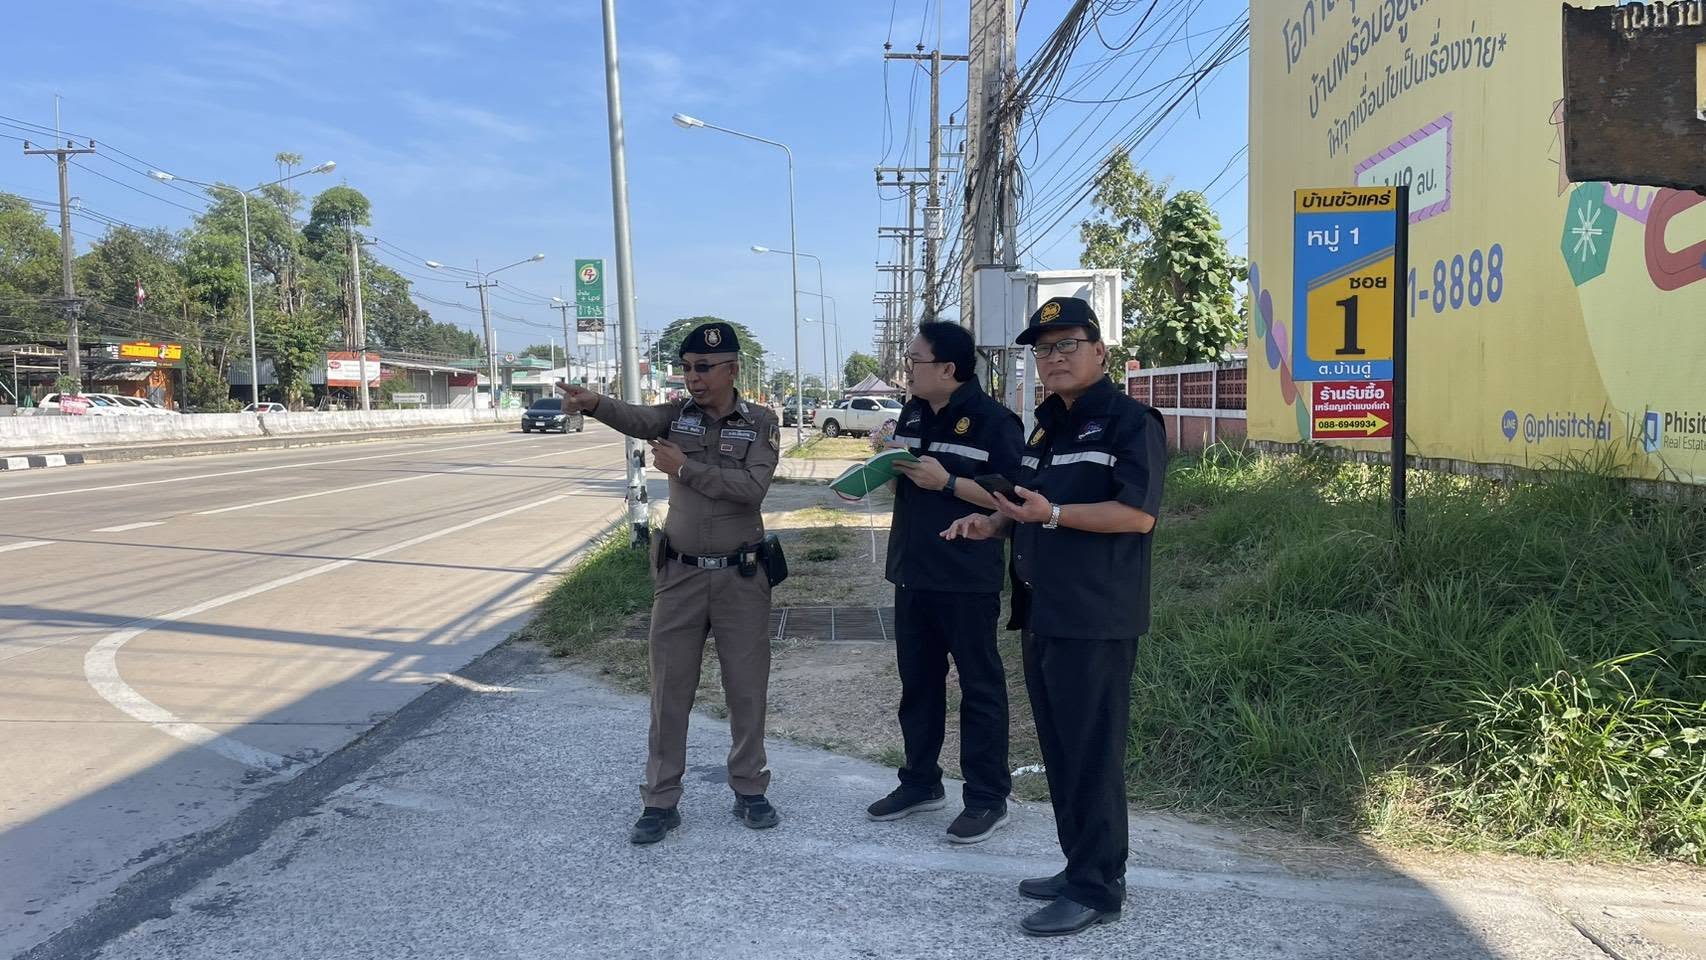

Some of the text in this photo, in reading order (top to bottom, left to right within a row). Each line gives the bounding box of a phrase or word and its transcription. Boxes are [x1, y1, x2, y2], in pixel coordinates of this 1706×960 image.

[1302, 190, 1391, 208] บ้านขัวแคร่
[1307, 225, 1359, 252] หมู่ 1
[1349, 277, 1387, 289] ซอย
[1335, 295, 1365, 355] 1
[1318, 362, 1371, 379] ต.บ้านดู่
[1503, 411, 1612, 444] LINE @phisitchai
[1663, 435, 1682, 449] Real
